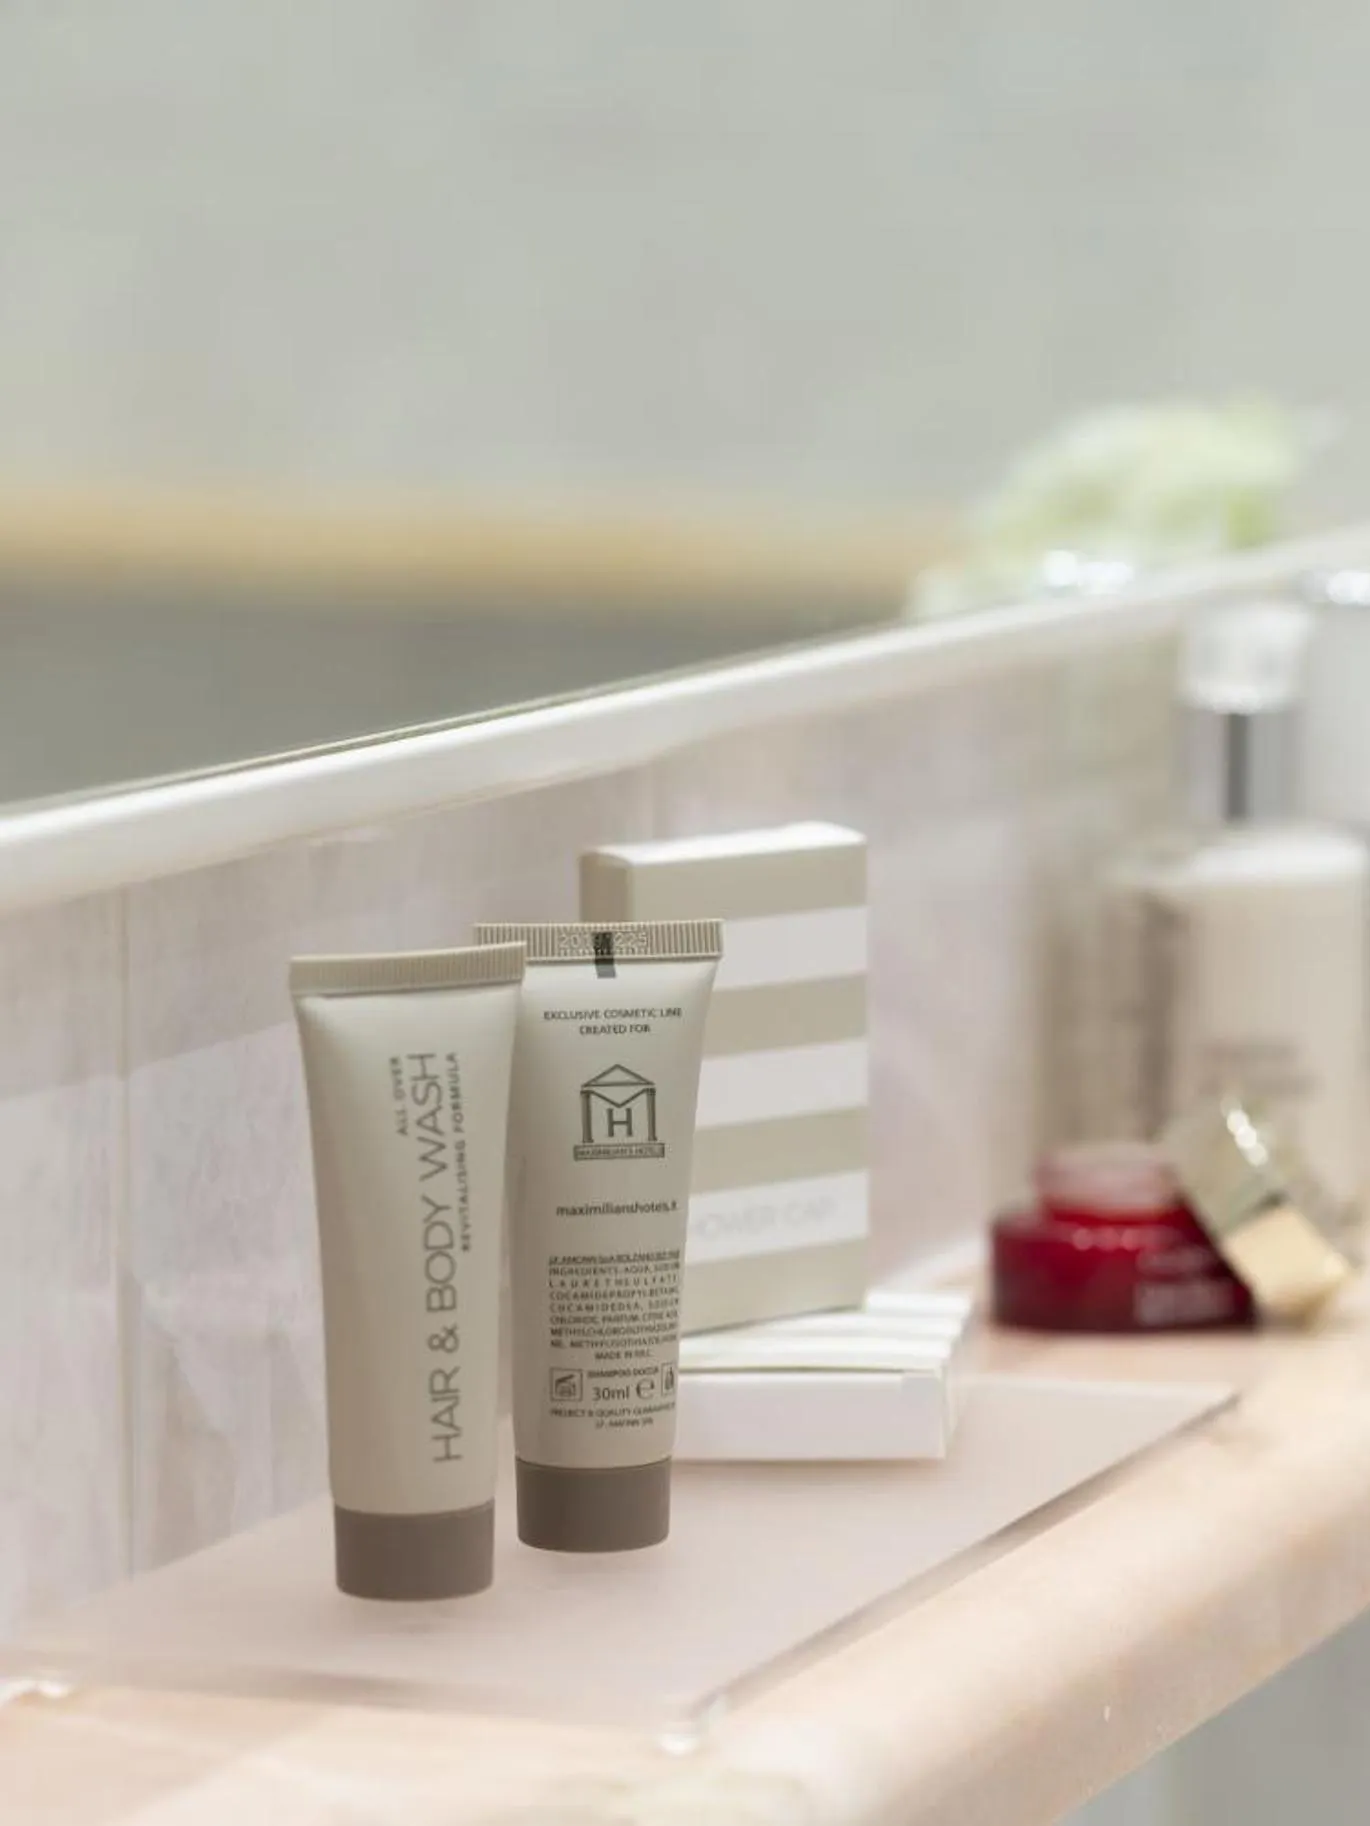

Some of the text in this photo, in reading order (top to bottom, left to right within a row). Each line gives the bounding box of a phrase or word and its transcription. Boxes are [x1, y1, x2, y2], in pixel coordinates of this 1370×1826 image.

[543, 1007, 682, 1021] EXCLUSIVE COSMETIC LINE
[579, 1023, 650, 1035] CREATED FOR
[446, 1052, 464, 1135] FORMULA
[394, 1108, 408, 1137] ALL
[405, 1052, 463, 1464] HAIR & BODY WASH
[591, 1385, 631, 1402] 30ml
